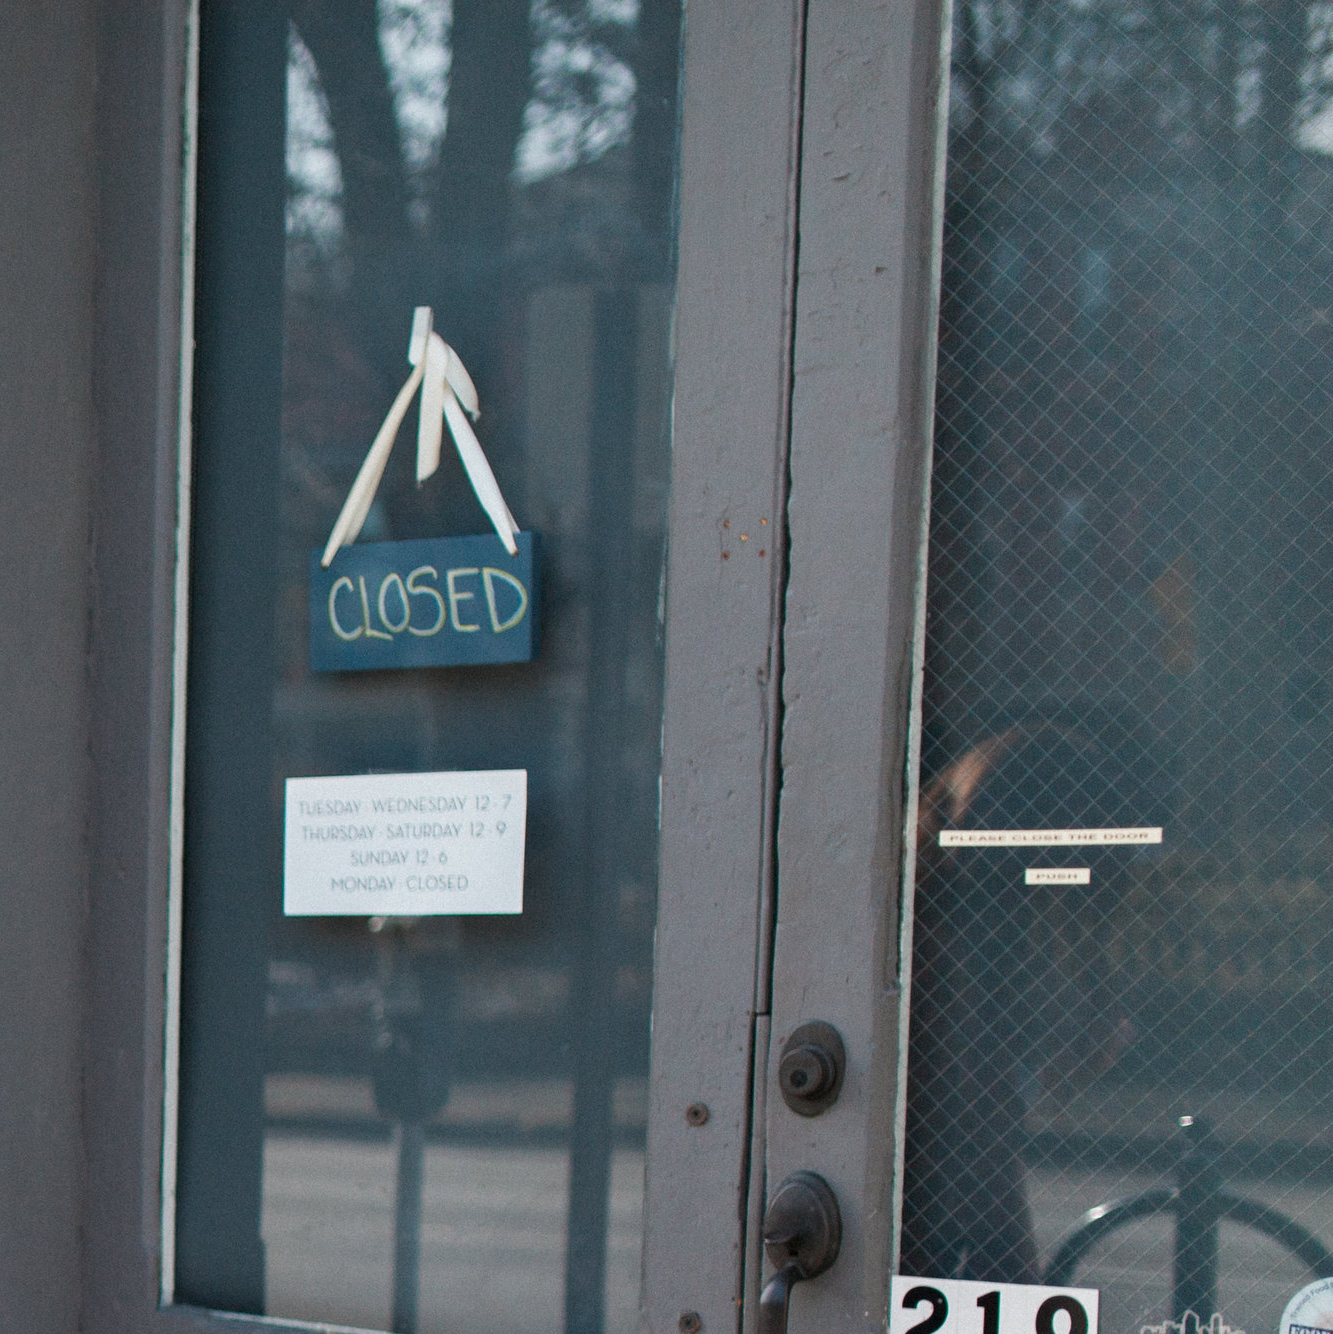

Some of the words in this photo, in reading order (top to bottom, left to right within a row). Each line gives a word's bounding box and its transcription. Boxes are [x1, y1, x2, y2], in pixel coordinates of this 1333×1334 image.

[329, 566, 528, 642] CLOSED
[299, 799, 362, 816] TUESDAY
[372, 795, 468, 813] WEDNESDAY
[301, 825, 376, 842] THURSDAY
[386, 822, 462, 840] SATURDAY
[950, 834, 1007, 843] PLEASE
[1012, 834, 1063, 842] CLOSE
[1069, 833, 1098, 842] THE
[1103, 832, 1149, 841] DOOR
[350, 850, 409, 867] SUNDAY
[330, 875, 397, 893] MONDAY
[406, 874, 469, 892] CLOSED
[1036, 872, 1078, 881] PUSH
